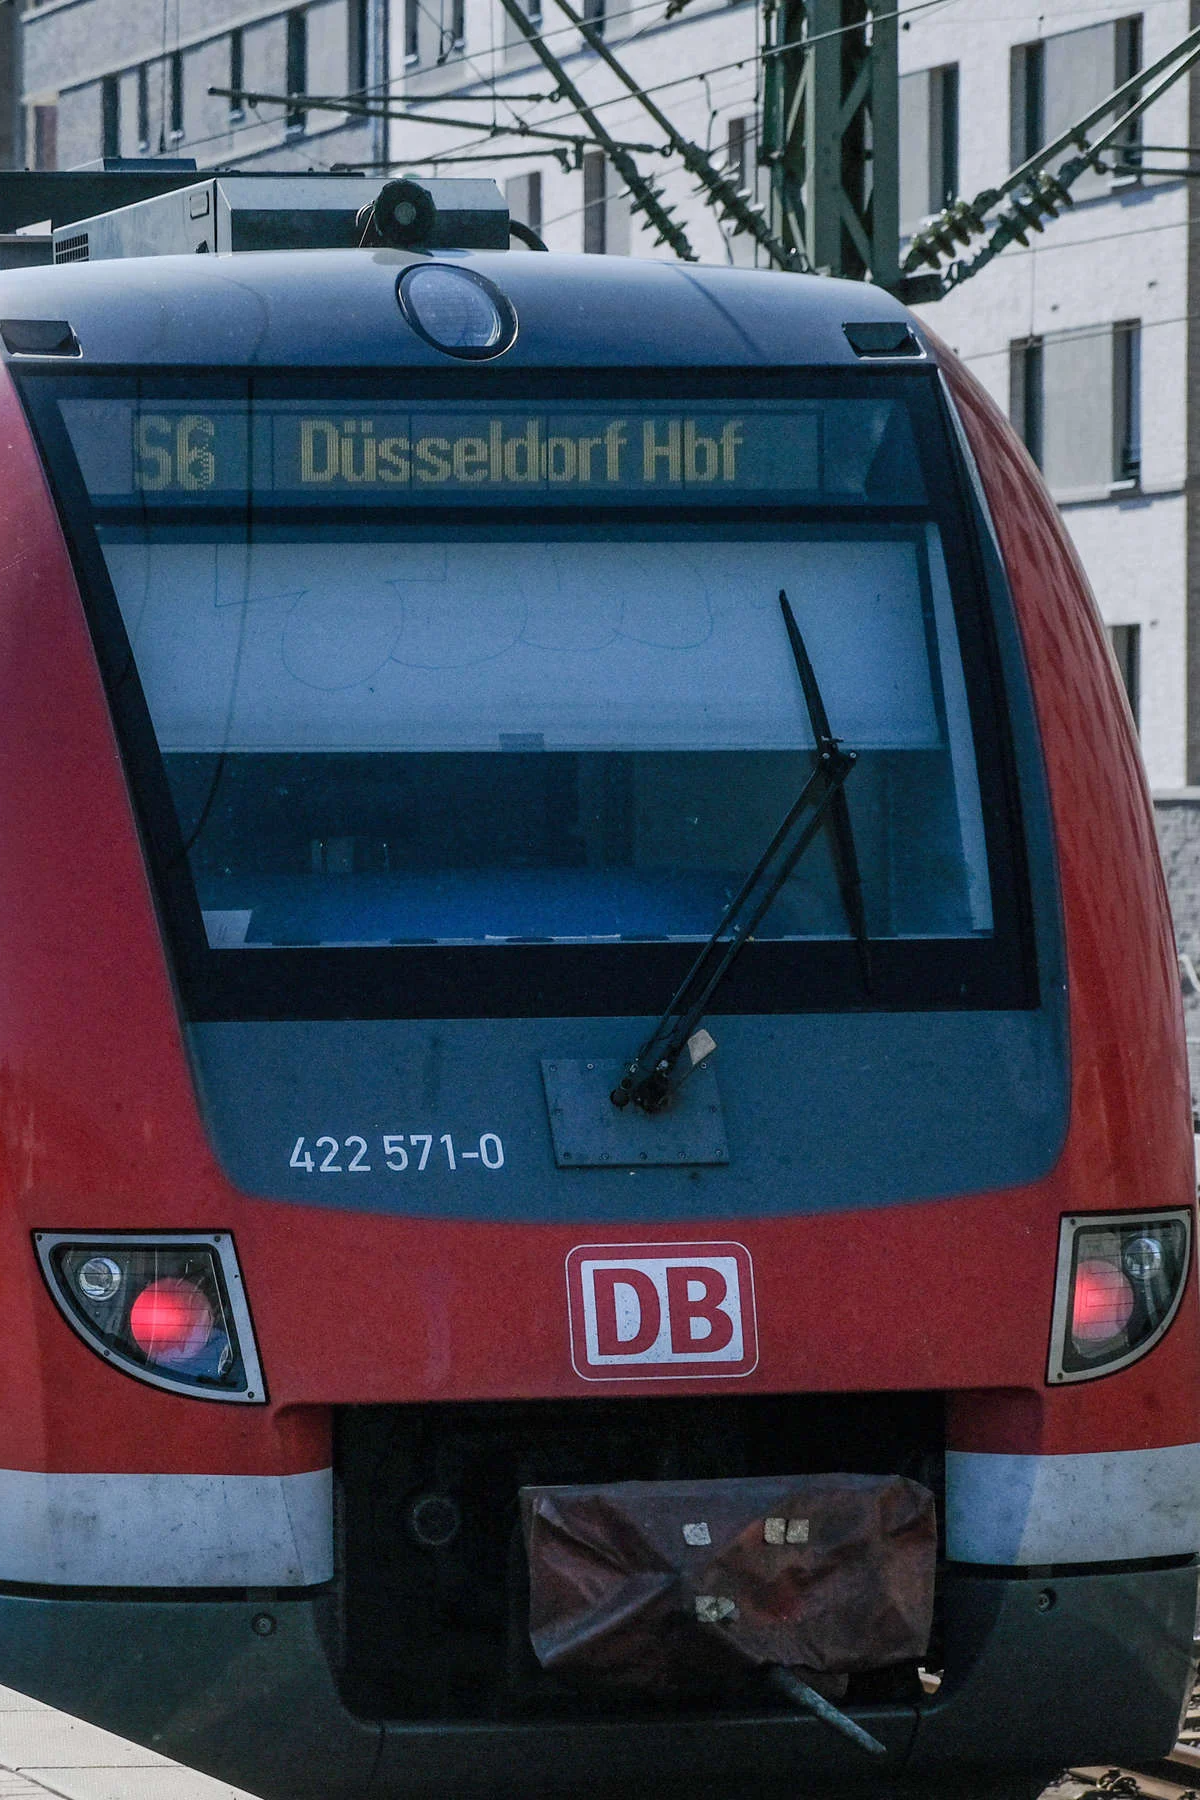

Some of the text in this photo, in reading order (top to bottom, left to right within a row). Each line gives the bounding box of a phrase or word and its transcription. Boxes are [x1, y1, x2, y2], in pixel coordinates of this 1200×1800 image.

[135, 416, 214, 491] S6
[301, 418, 743, 482] Düsseldorf Hbf
[289, 1133, 505, 1173] 422 571-0
[593, 1265, 734, 1356] DB
